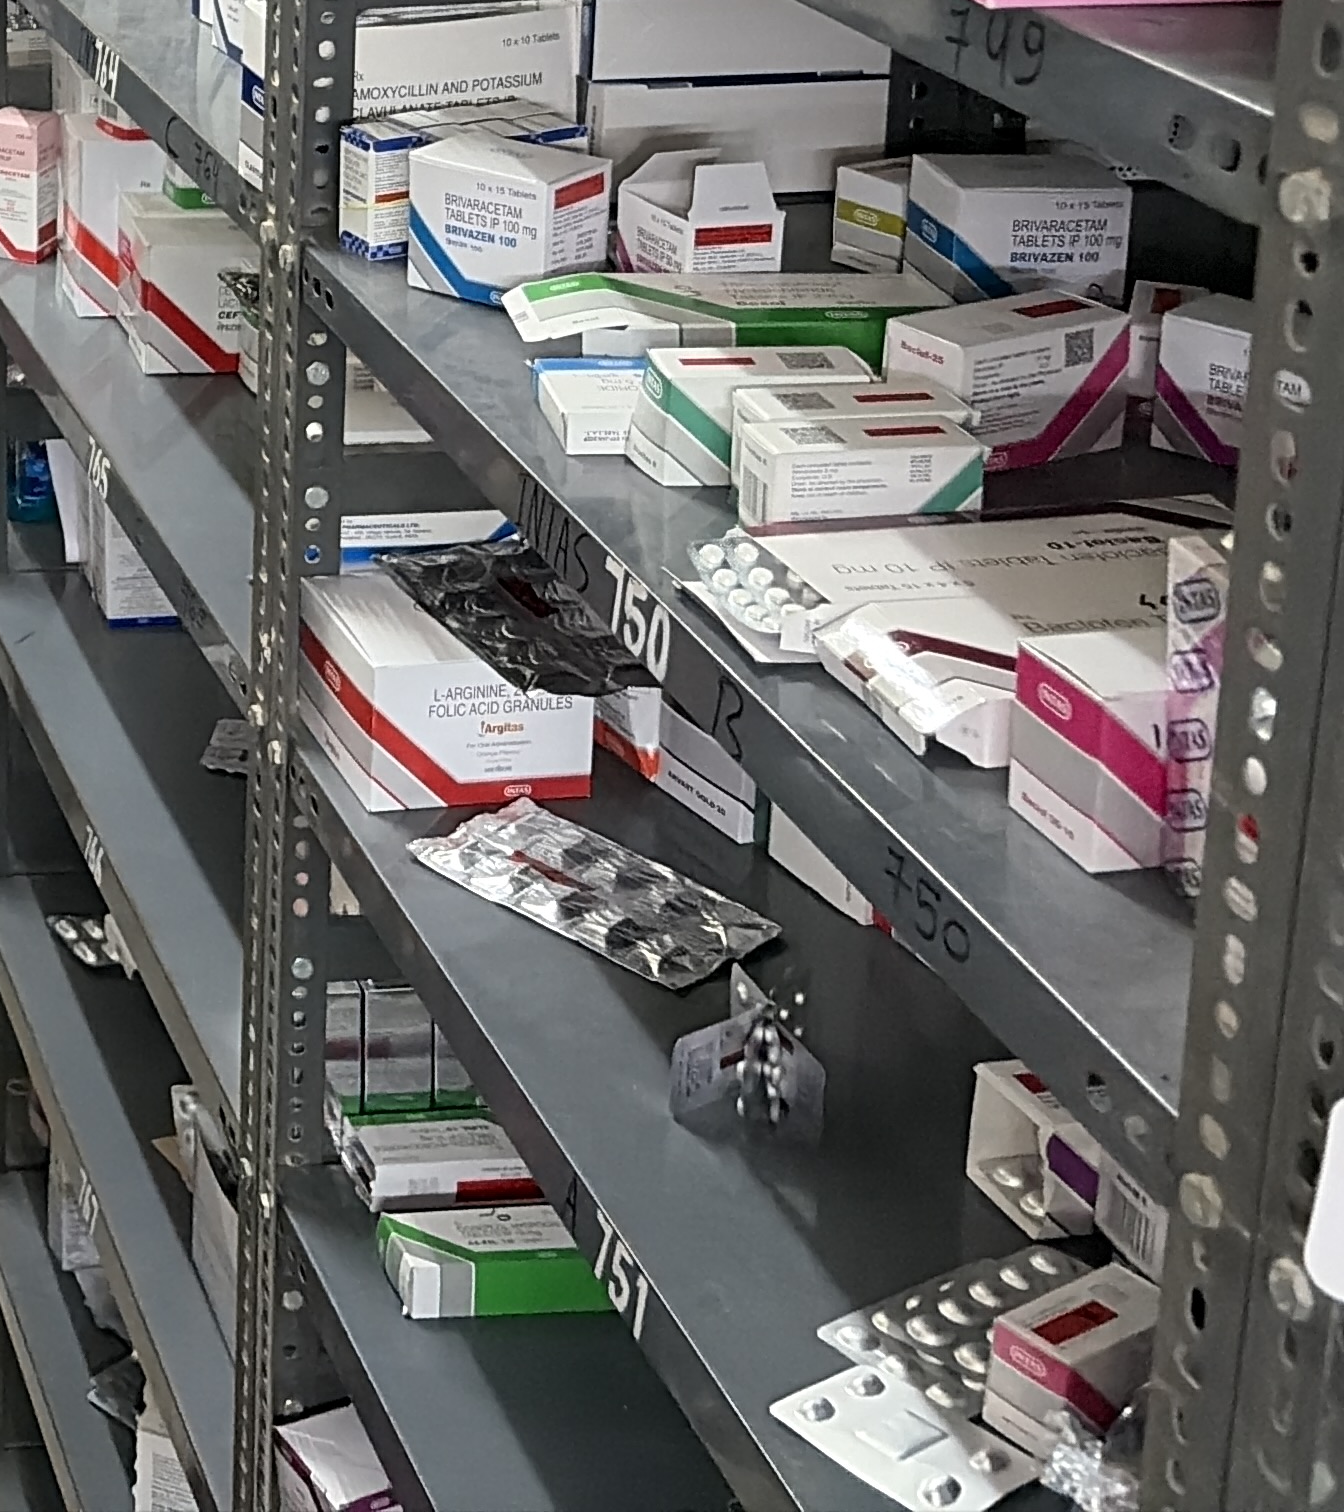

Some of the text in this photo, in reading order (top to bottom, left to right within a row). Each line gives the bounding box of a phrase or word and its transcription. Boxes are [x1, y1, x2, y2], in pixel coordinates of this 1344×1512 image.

[502, 32, 560, 47] 10 10 Tablets
[353, 71, 543, 101] AMOXYCILLIN AND POTASSIUM
[476, 182, 537, 200] 10 15 Tablets
[444, 192, 523, 219] BRIVARACETAM
[445, 207, 537, 239] TABLETS IP 100 mg
[1012, 219, 1108, 233] BRIVARACETAM
[444, 224, 517, 248] BRIVAZEN 100
[1011, 233, 1122, 248] TABLETS IP 100 mg
[1010, 251, 1099, 263] BRIVAZEN 100
[884, 562, 916, 574] 10
[433, 684, 510, 702] L-ARGININE,
[428, 697, 573, 719] FOLIC ACID GRANULES
[484, 722, 524, 736] Argitas
